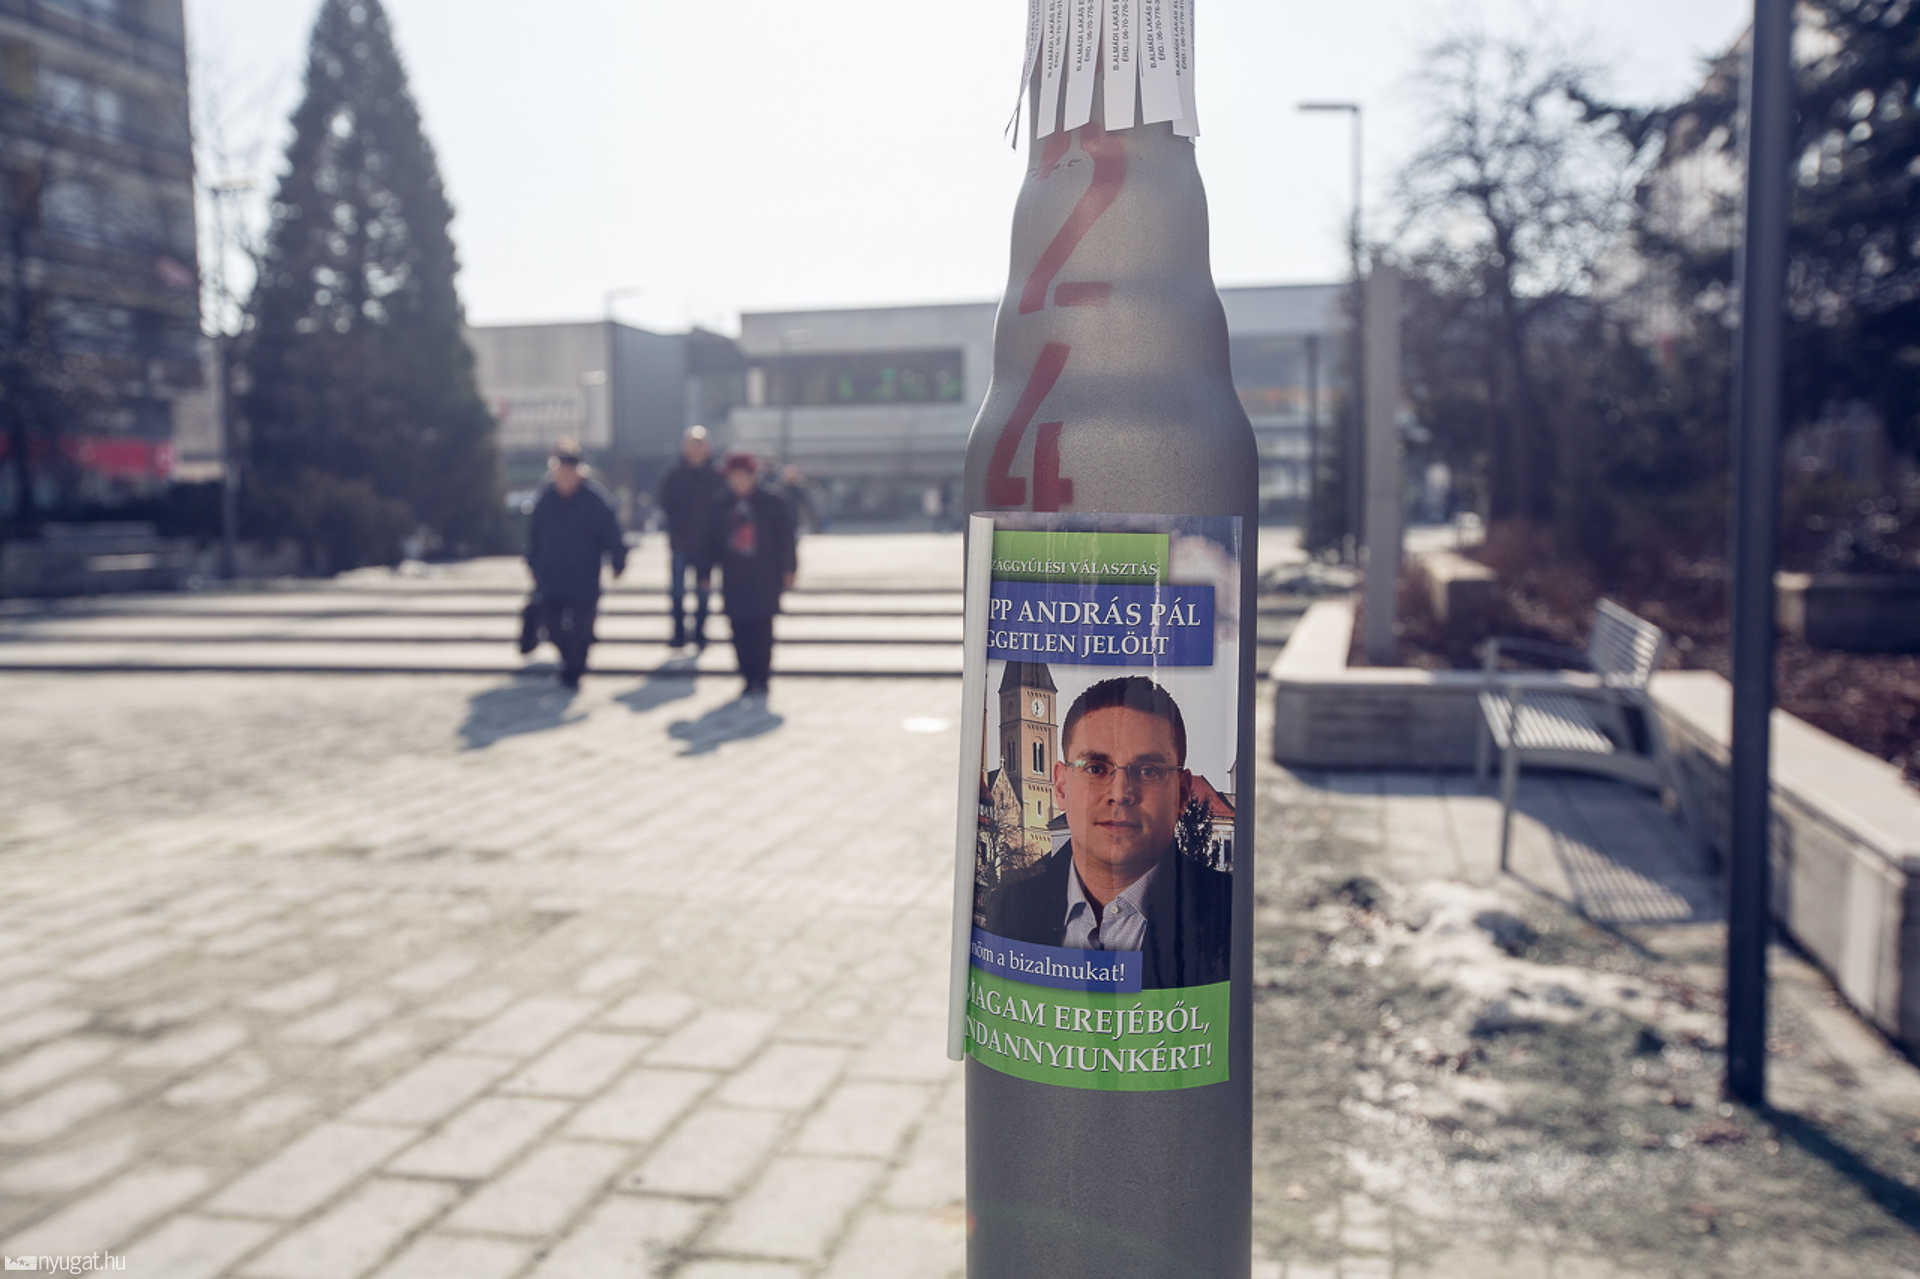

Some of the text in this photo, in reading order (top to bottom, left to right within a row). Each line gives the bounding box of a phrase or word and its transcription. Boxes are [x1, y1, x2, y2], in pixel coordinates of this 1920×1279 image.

[1070, 559, 1158, 577] VÁLASZTÁS
[990, 596, 1201, 627] PP ANDRÁS PÁL
[1081, 631, 1168, 658] JELÖLT
[997, 951, 1006, 968] a
[1009, 949, 1126, 982] bizalmukat!
[1053, 1000, 1210, 1041] EREJÉBŐL,
